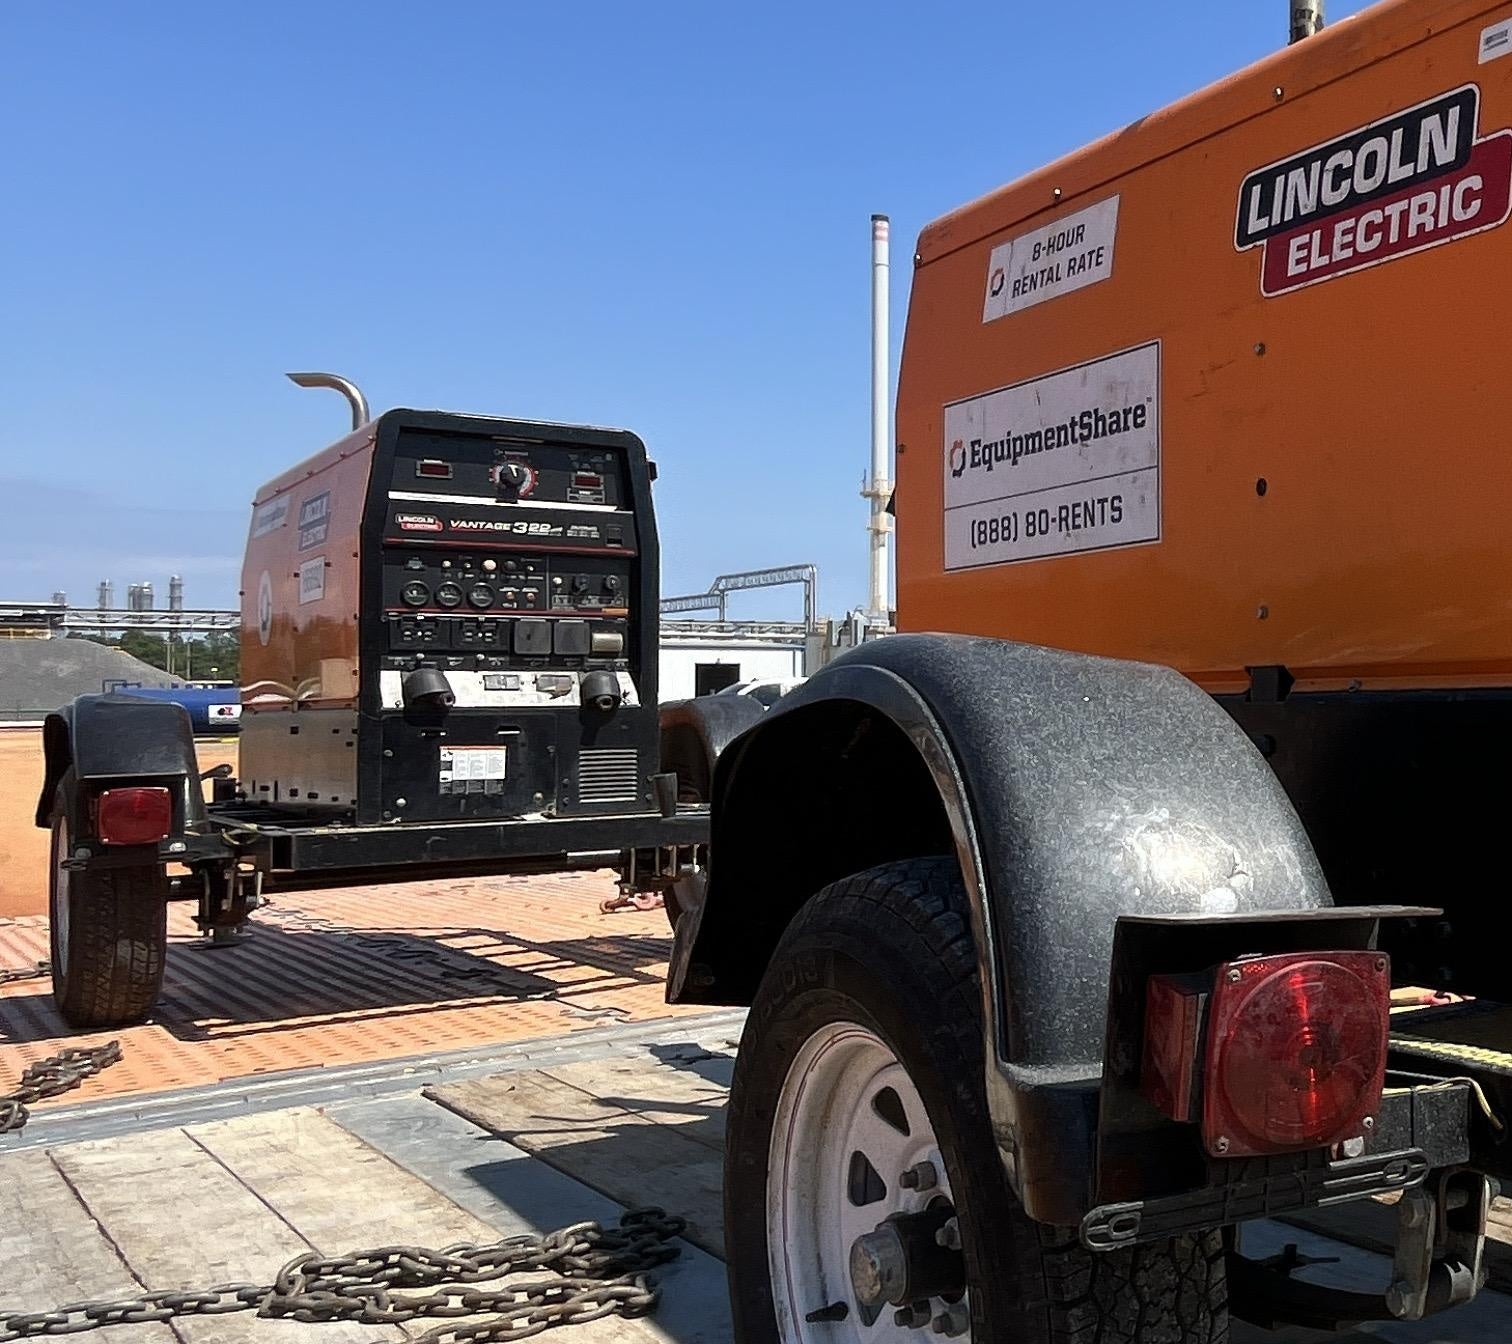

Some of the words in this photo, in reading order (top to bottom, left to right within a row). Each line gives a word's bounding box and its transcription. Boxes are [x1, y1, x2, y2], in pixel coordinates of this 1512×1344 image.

[1247, 104, 1461, 235] LINCOLN
[1031, 223, 1085, 262] 8-HOUR
[1286, 174, 1483, 278] ELECTRIC
[1011, 263, 1062, 299] RENTAL
[1067, 246, 1105, 278] RATE
[969, 403, 1147, 472] EquipmentShare
[450, 519, 512, 532] VANTAGE
[512, 521, 552, 535] 322
[970, 512, 1019, 549] (888)
[1025, 495, 1124, 538] 80-RENTS
